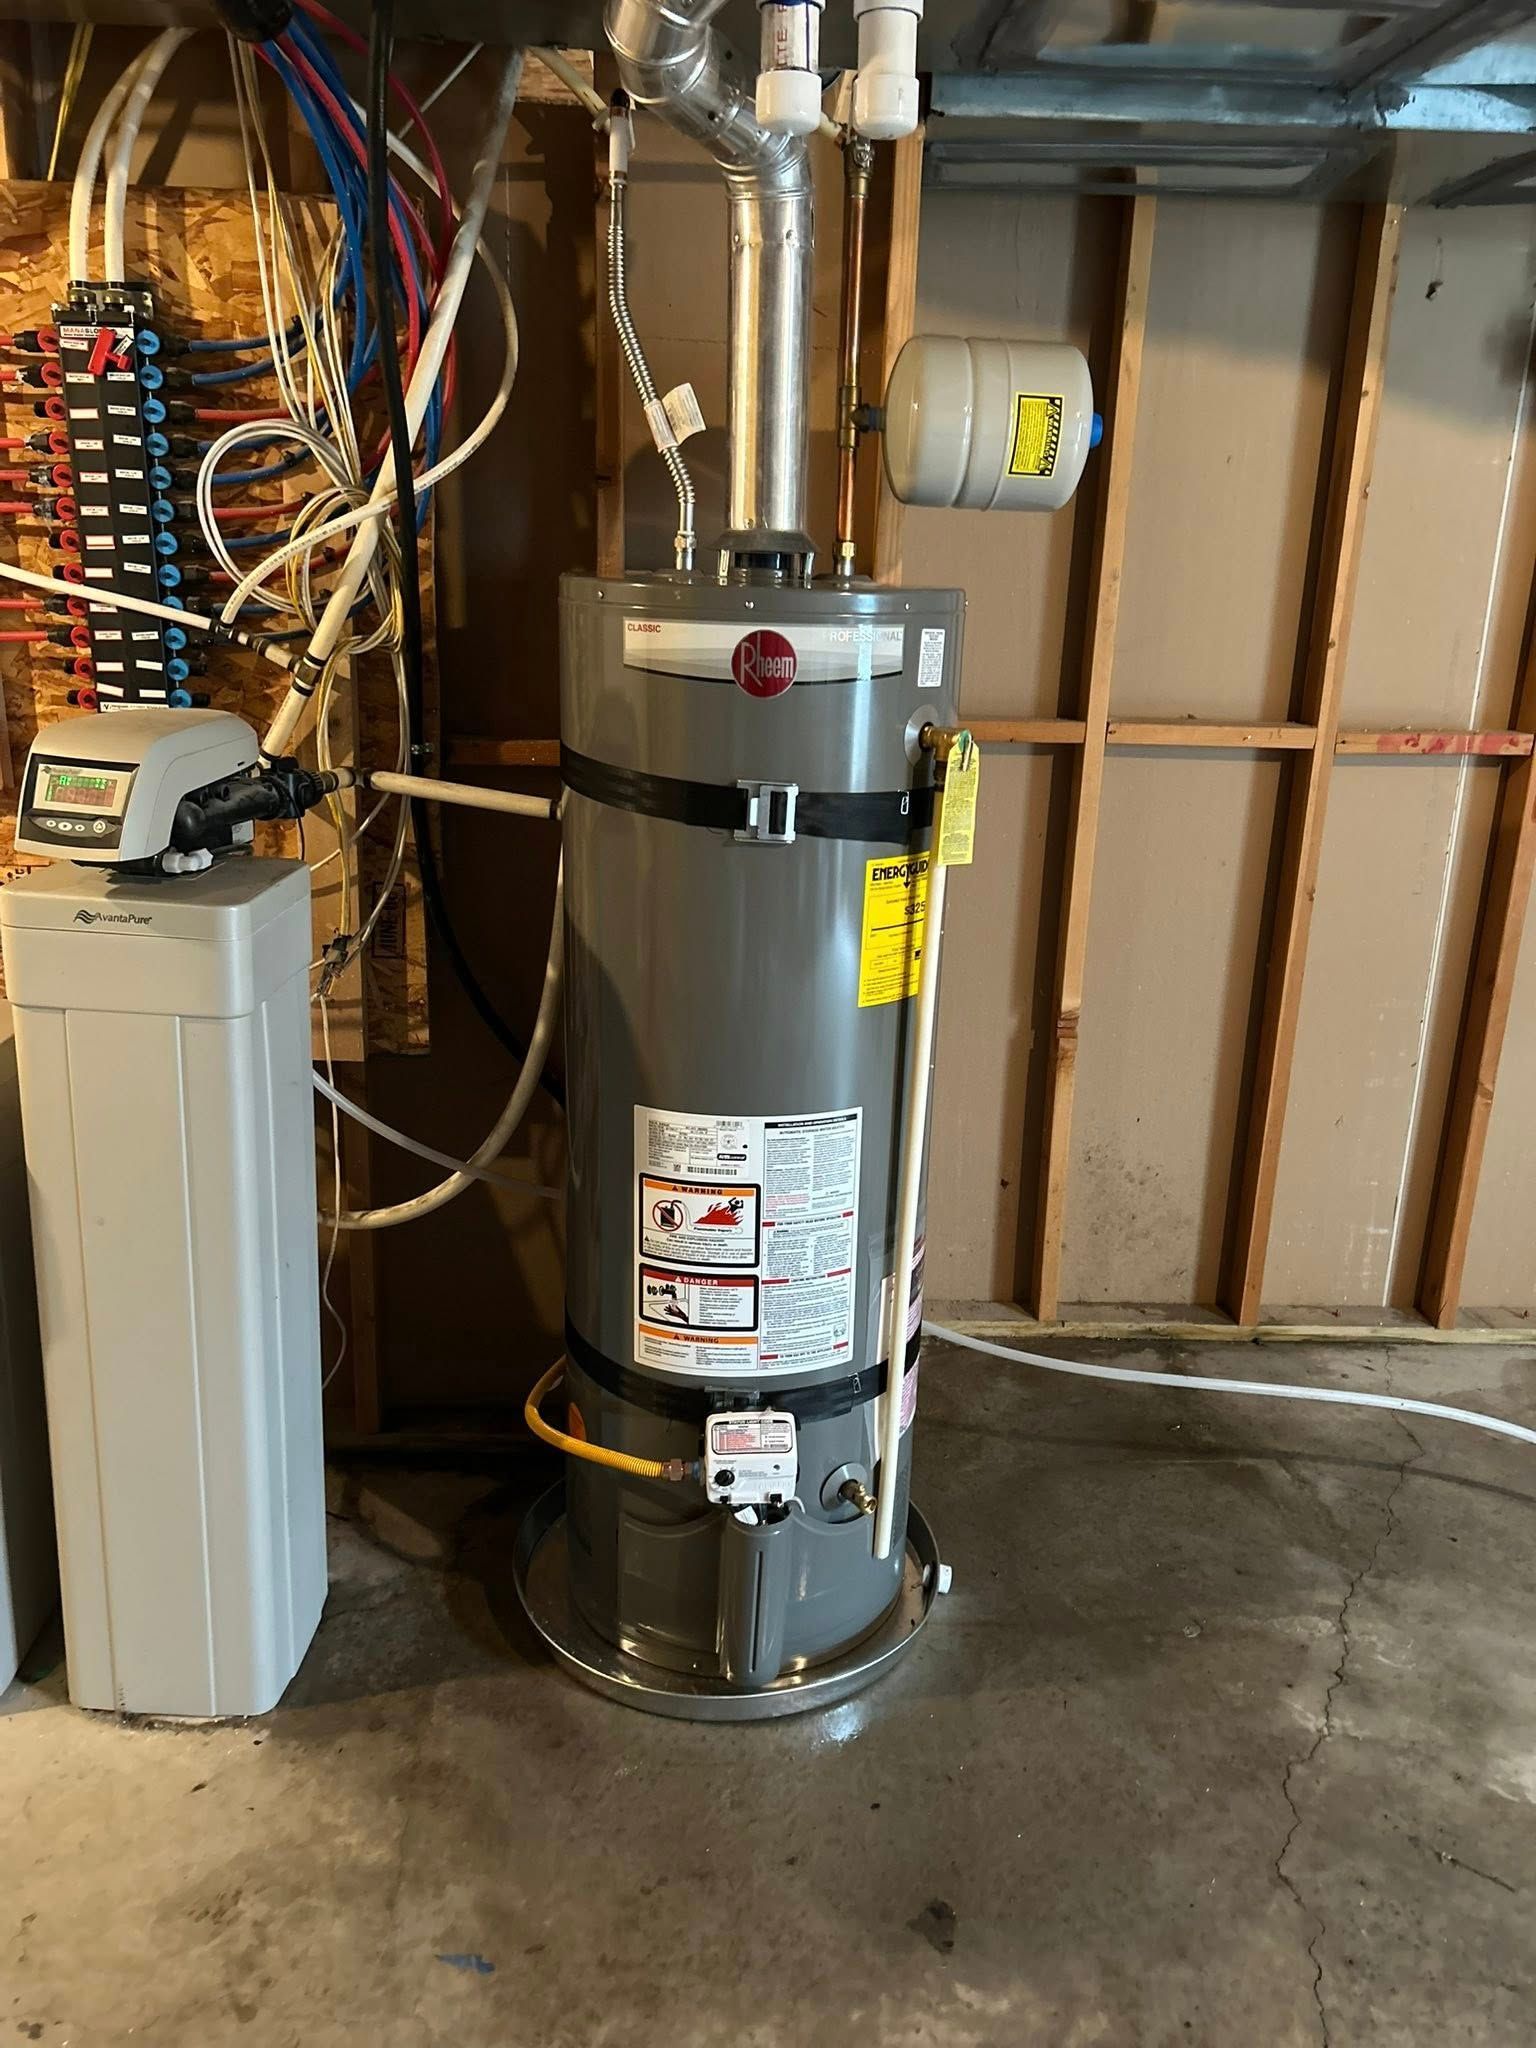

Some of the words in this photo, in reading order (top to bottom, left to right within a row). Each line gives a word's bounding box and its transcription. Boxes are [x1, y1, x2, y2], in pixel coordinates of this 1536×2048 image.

[1043, 418, 1054, 457] WARNING
[627, 623, 661, 633] CLASSIC
[740, 632, 793, 686] Rheem
[872, 860, 929, 882] ENERGYGUID
[95, 912, 151, 925] AvantaPure
[681, 1186, 723, 1195] WARNING
[684, 1278, 718, 1286] DANGER
[683, 1335, 719, 1344] WARNING
